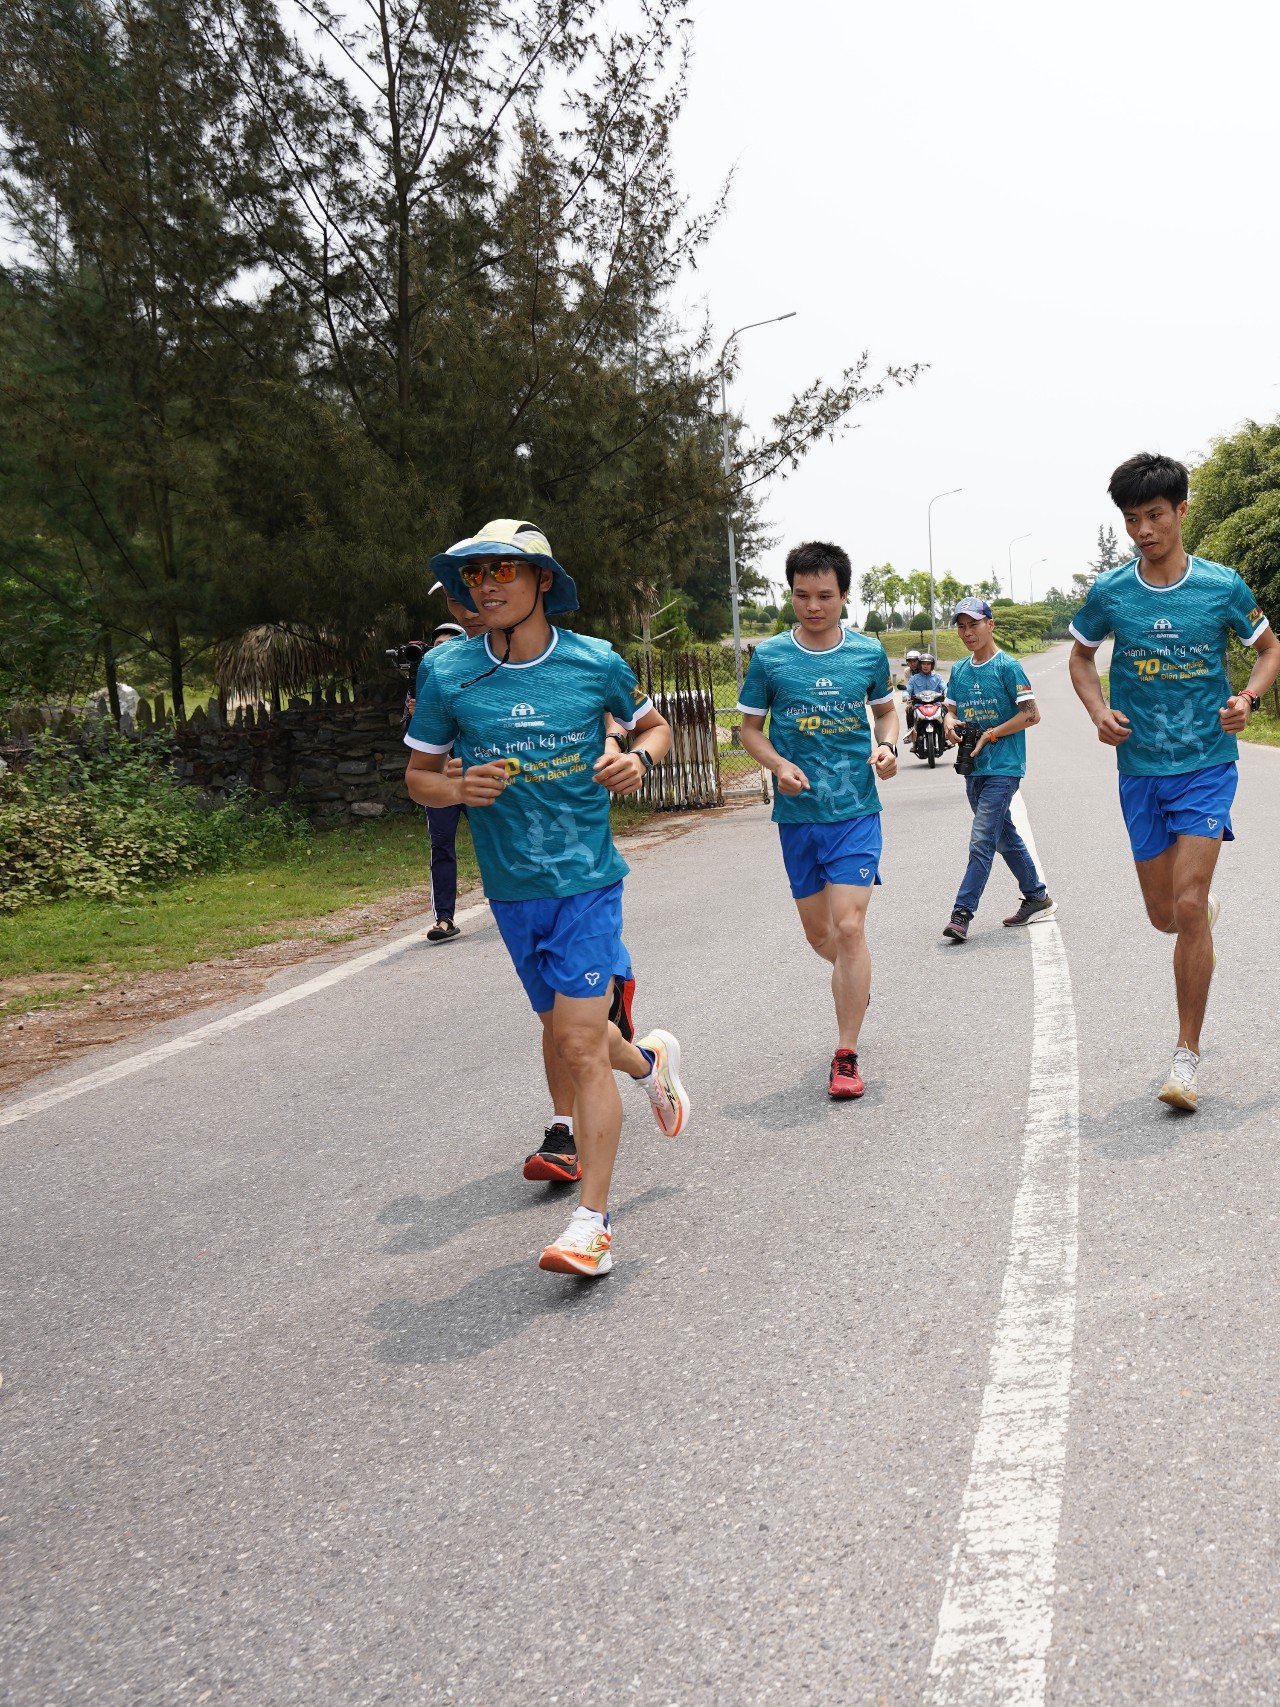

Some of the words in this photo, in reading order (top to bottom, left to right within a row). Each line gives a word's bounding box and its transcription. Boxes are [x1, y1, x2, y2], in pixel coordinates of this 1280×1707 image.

[1133, 658, 1160, 676] 70
[795, 715, 821, 732] 70
[505, 736, 536, 754] trình
[539, 733, 556, 750] kỷ
[560, 731, 586, 744] niệm
[505, 757, 521, 776] 0
